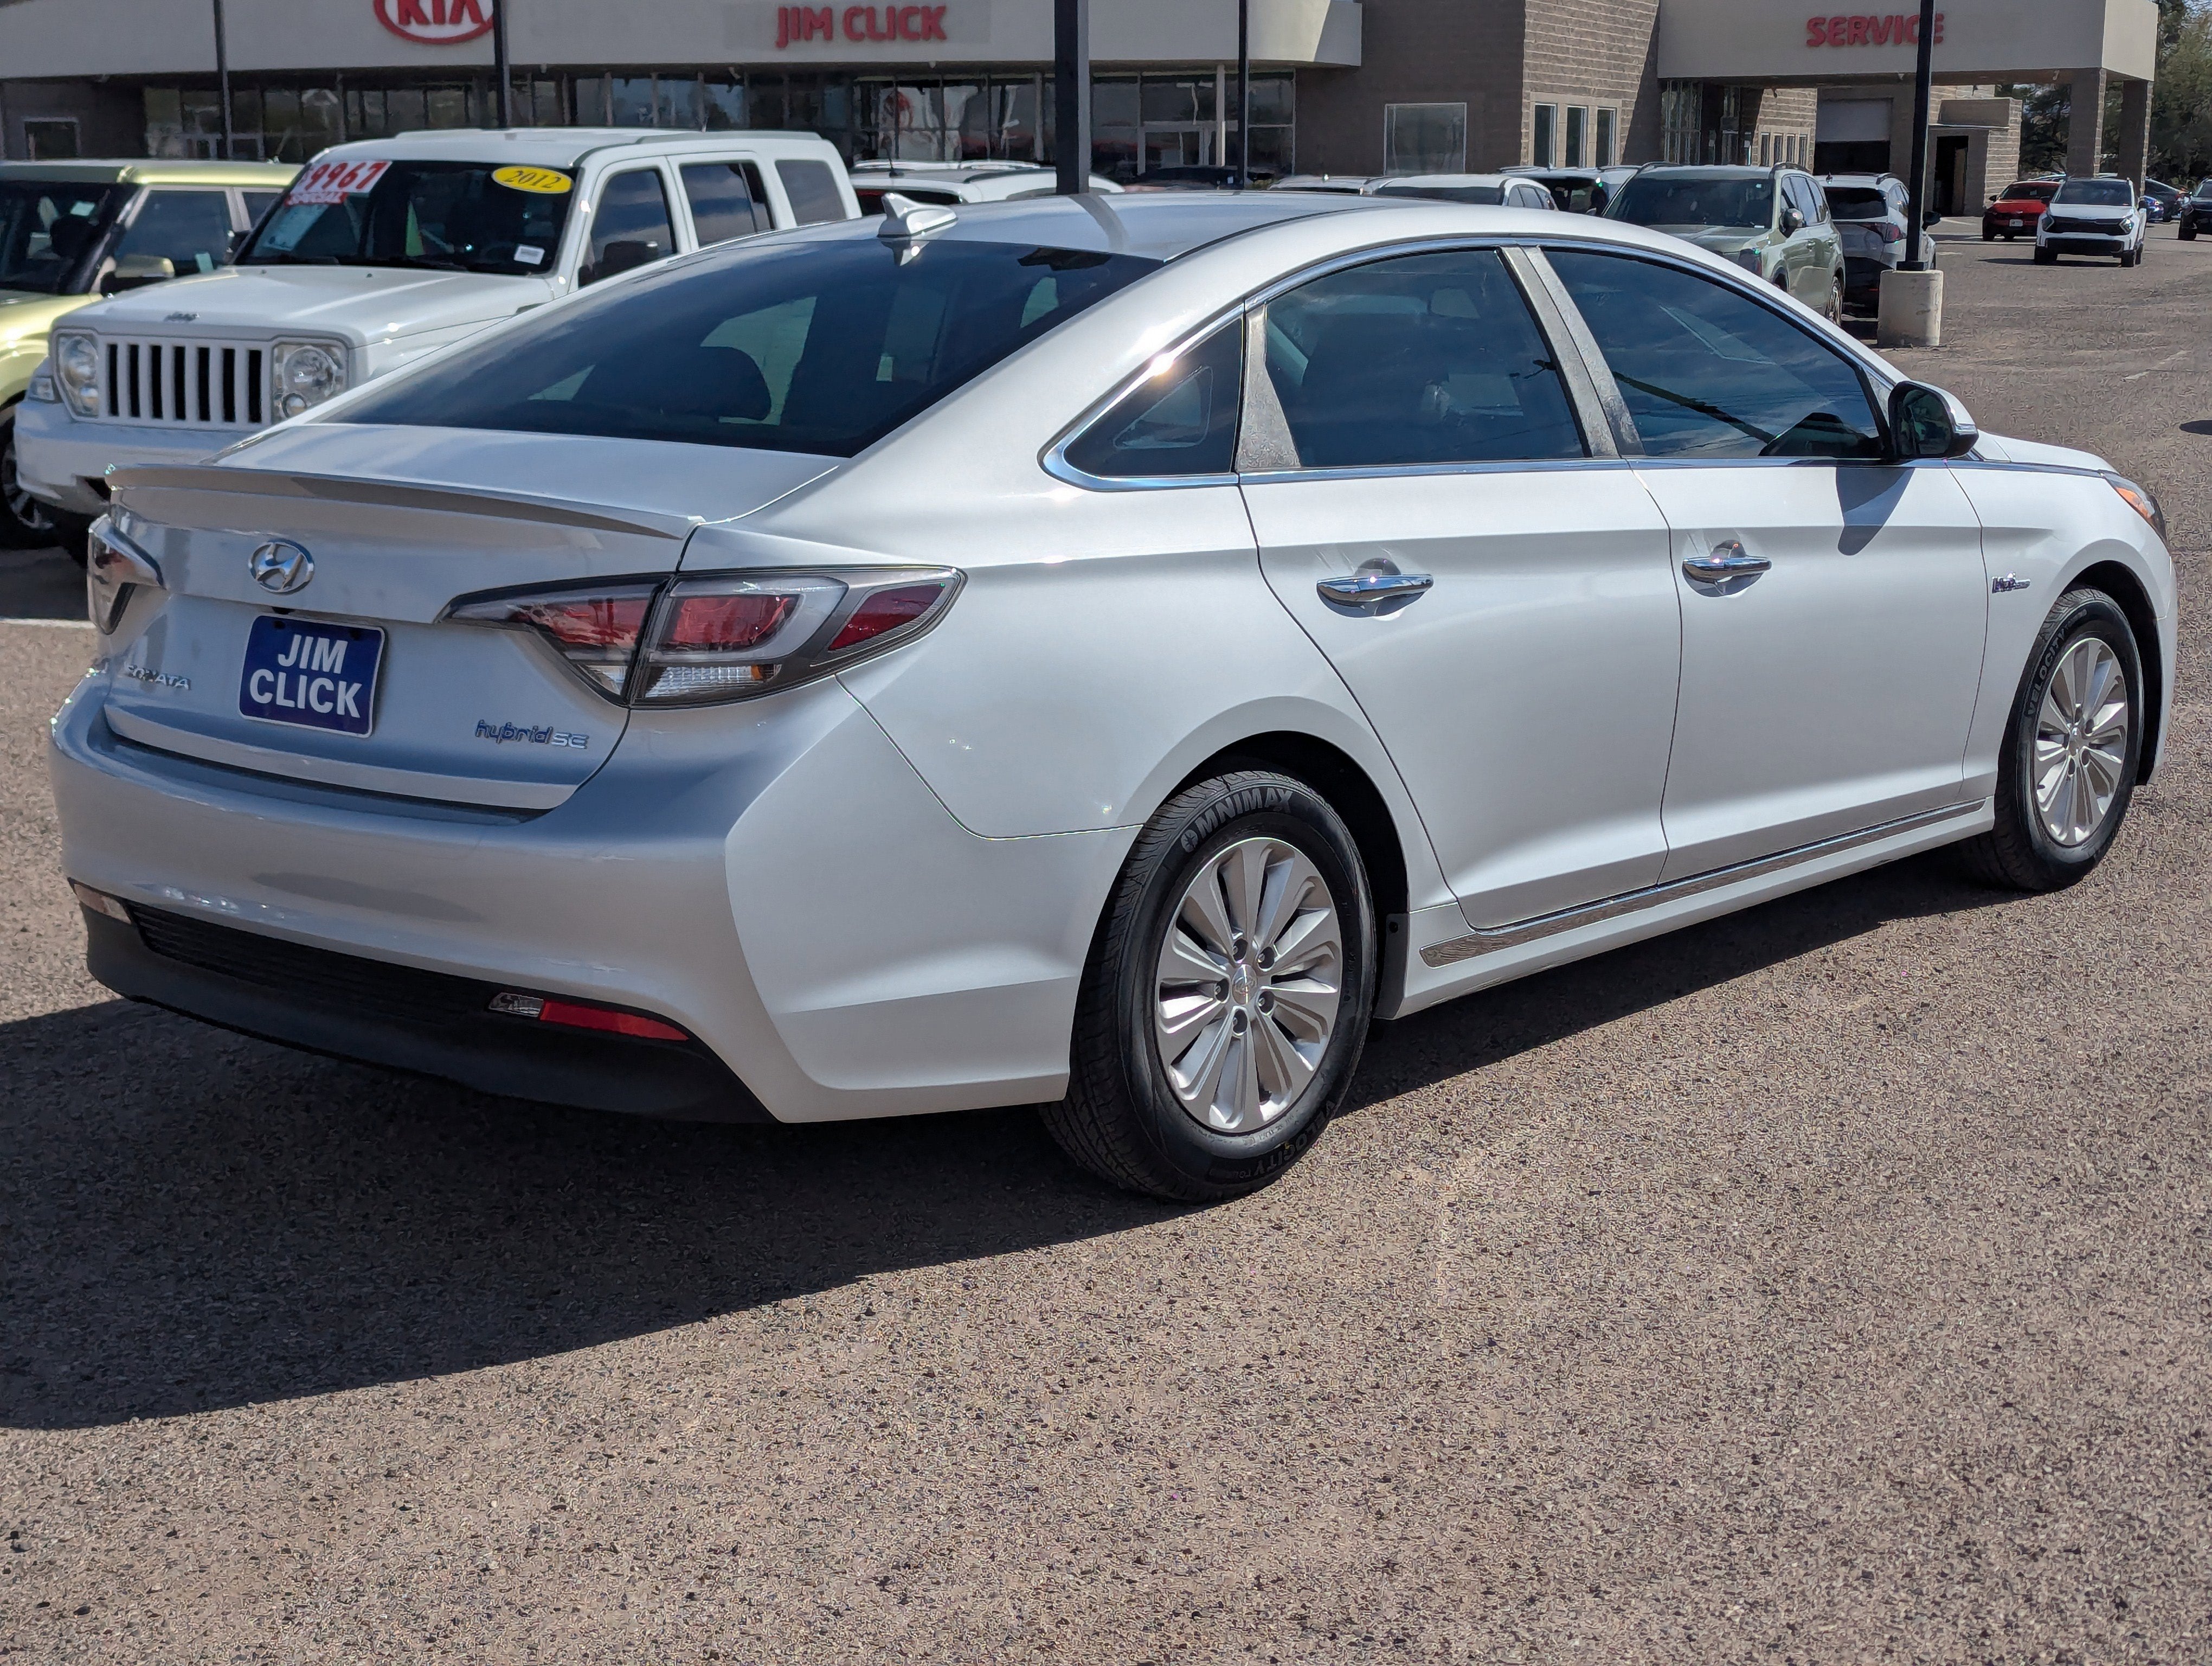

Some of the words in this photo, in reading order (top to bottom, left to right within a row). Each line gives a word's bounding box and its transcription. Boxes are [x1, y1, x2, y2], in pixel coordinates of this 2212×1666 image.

[775, 7, 833, 48] JIM
[843, 6, 947, 41] CLICK
[502, 170, 562, 189] 2012
[278, 633, 349, 674] JIM
[249, 669, 363, 719] CLICK
[1181, 786, 1294, 853] OMNIMAX
